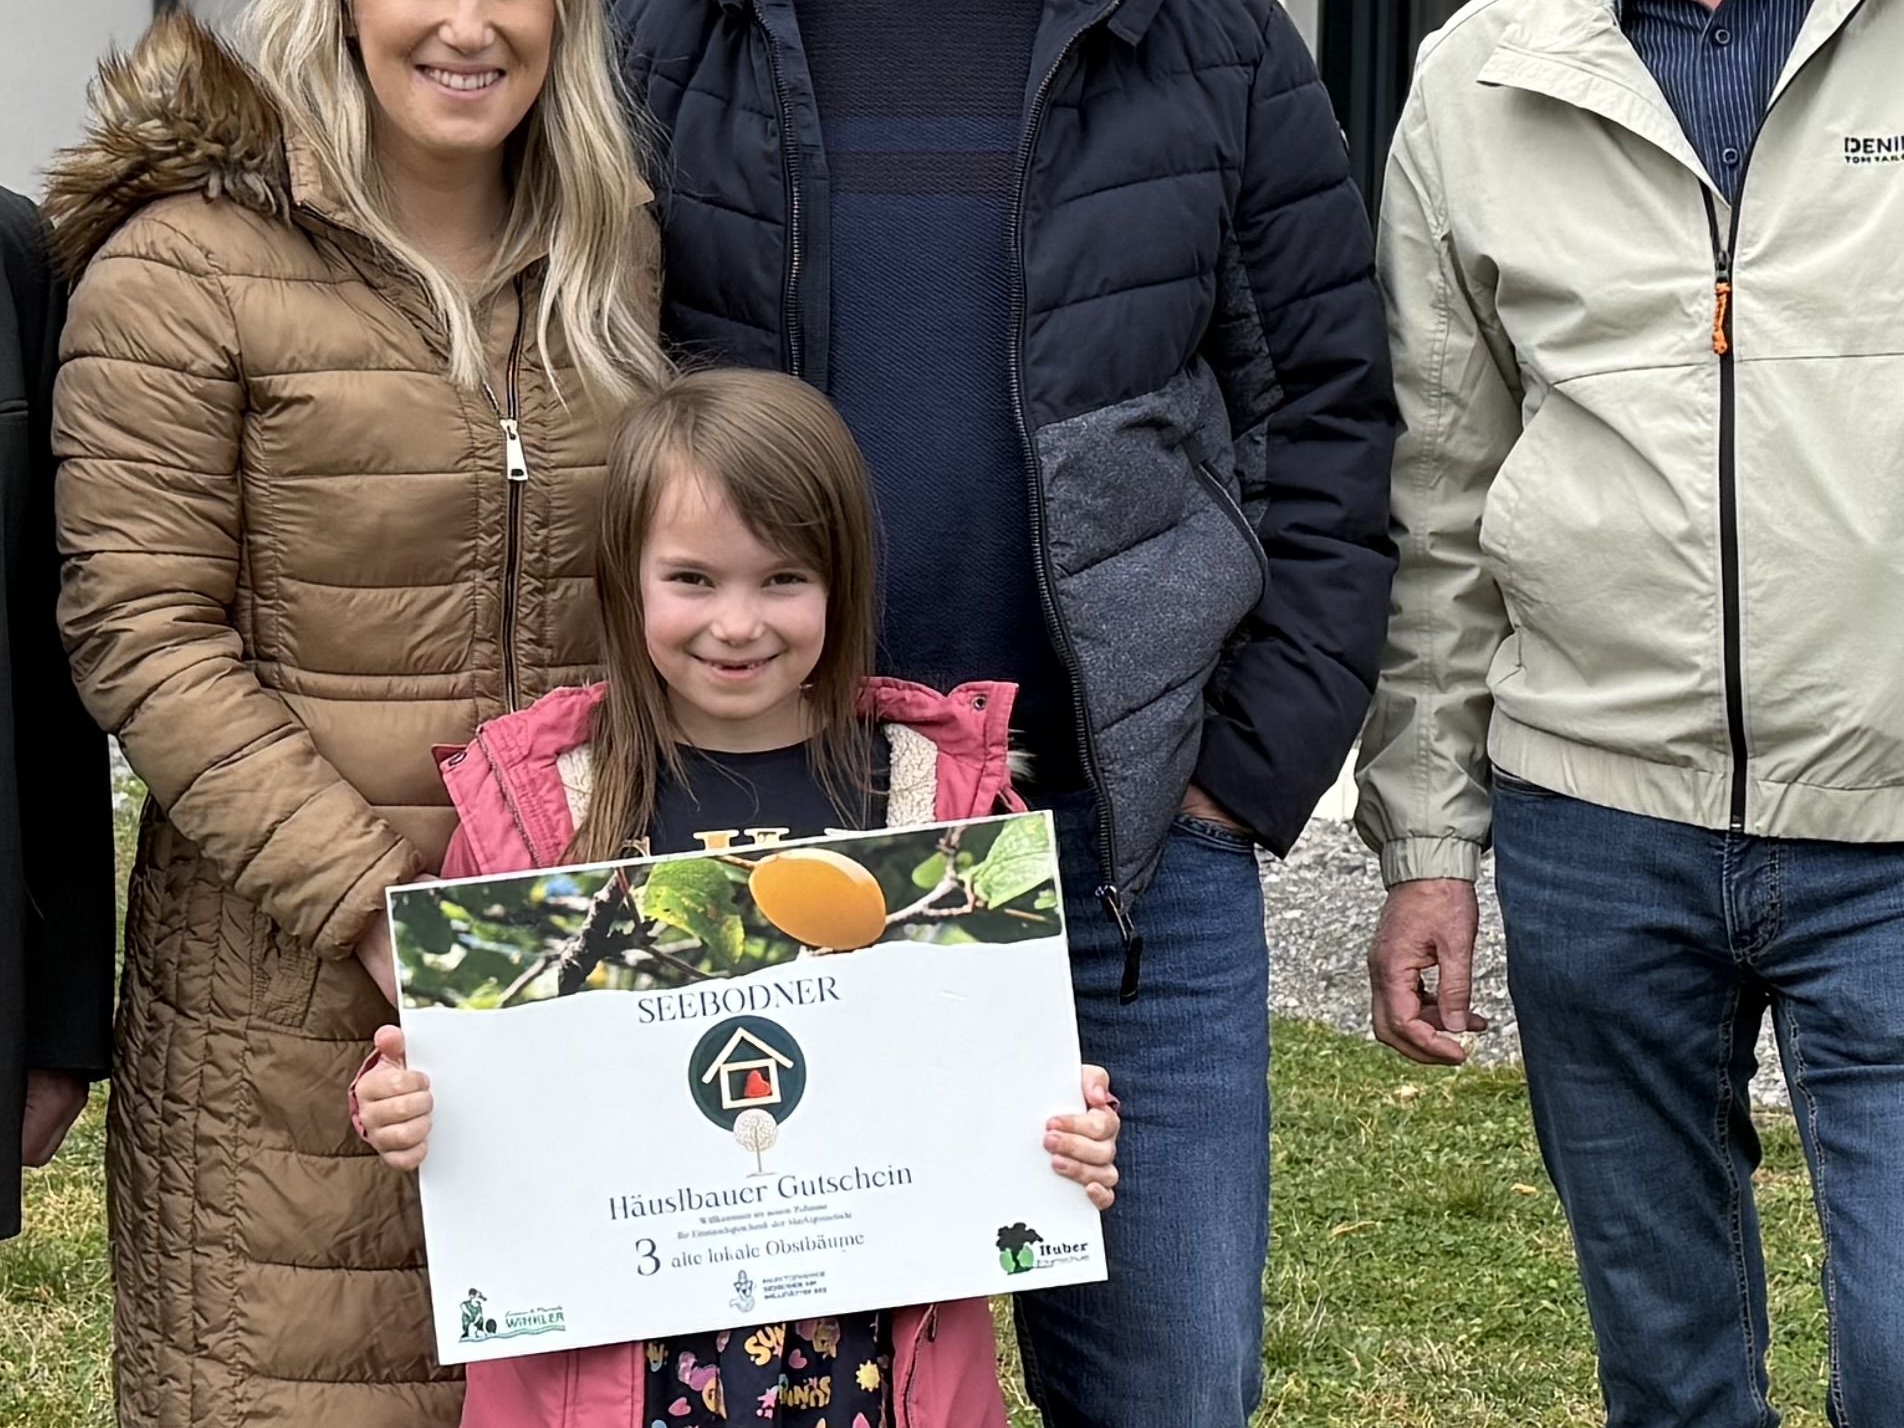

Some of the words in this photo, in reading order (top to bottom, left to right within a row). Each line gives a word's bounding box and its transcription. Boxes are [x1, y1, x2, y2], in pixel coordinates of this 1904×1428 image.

[637, 975, 841, 1024] SEEBODNER
[608, 1183, 769, 1220] Häuslbauer
[777, 1165, 914, 1199] Gutschein
[634, 1237, 662, 1277] 3
[671, 1251, 703, 1269] alte
[707, 1243, 761, 1265] lokale
[765, 1232, 865, 1257] Obstbäume
[1039, 1242, 1089, 1256] Huber
